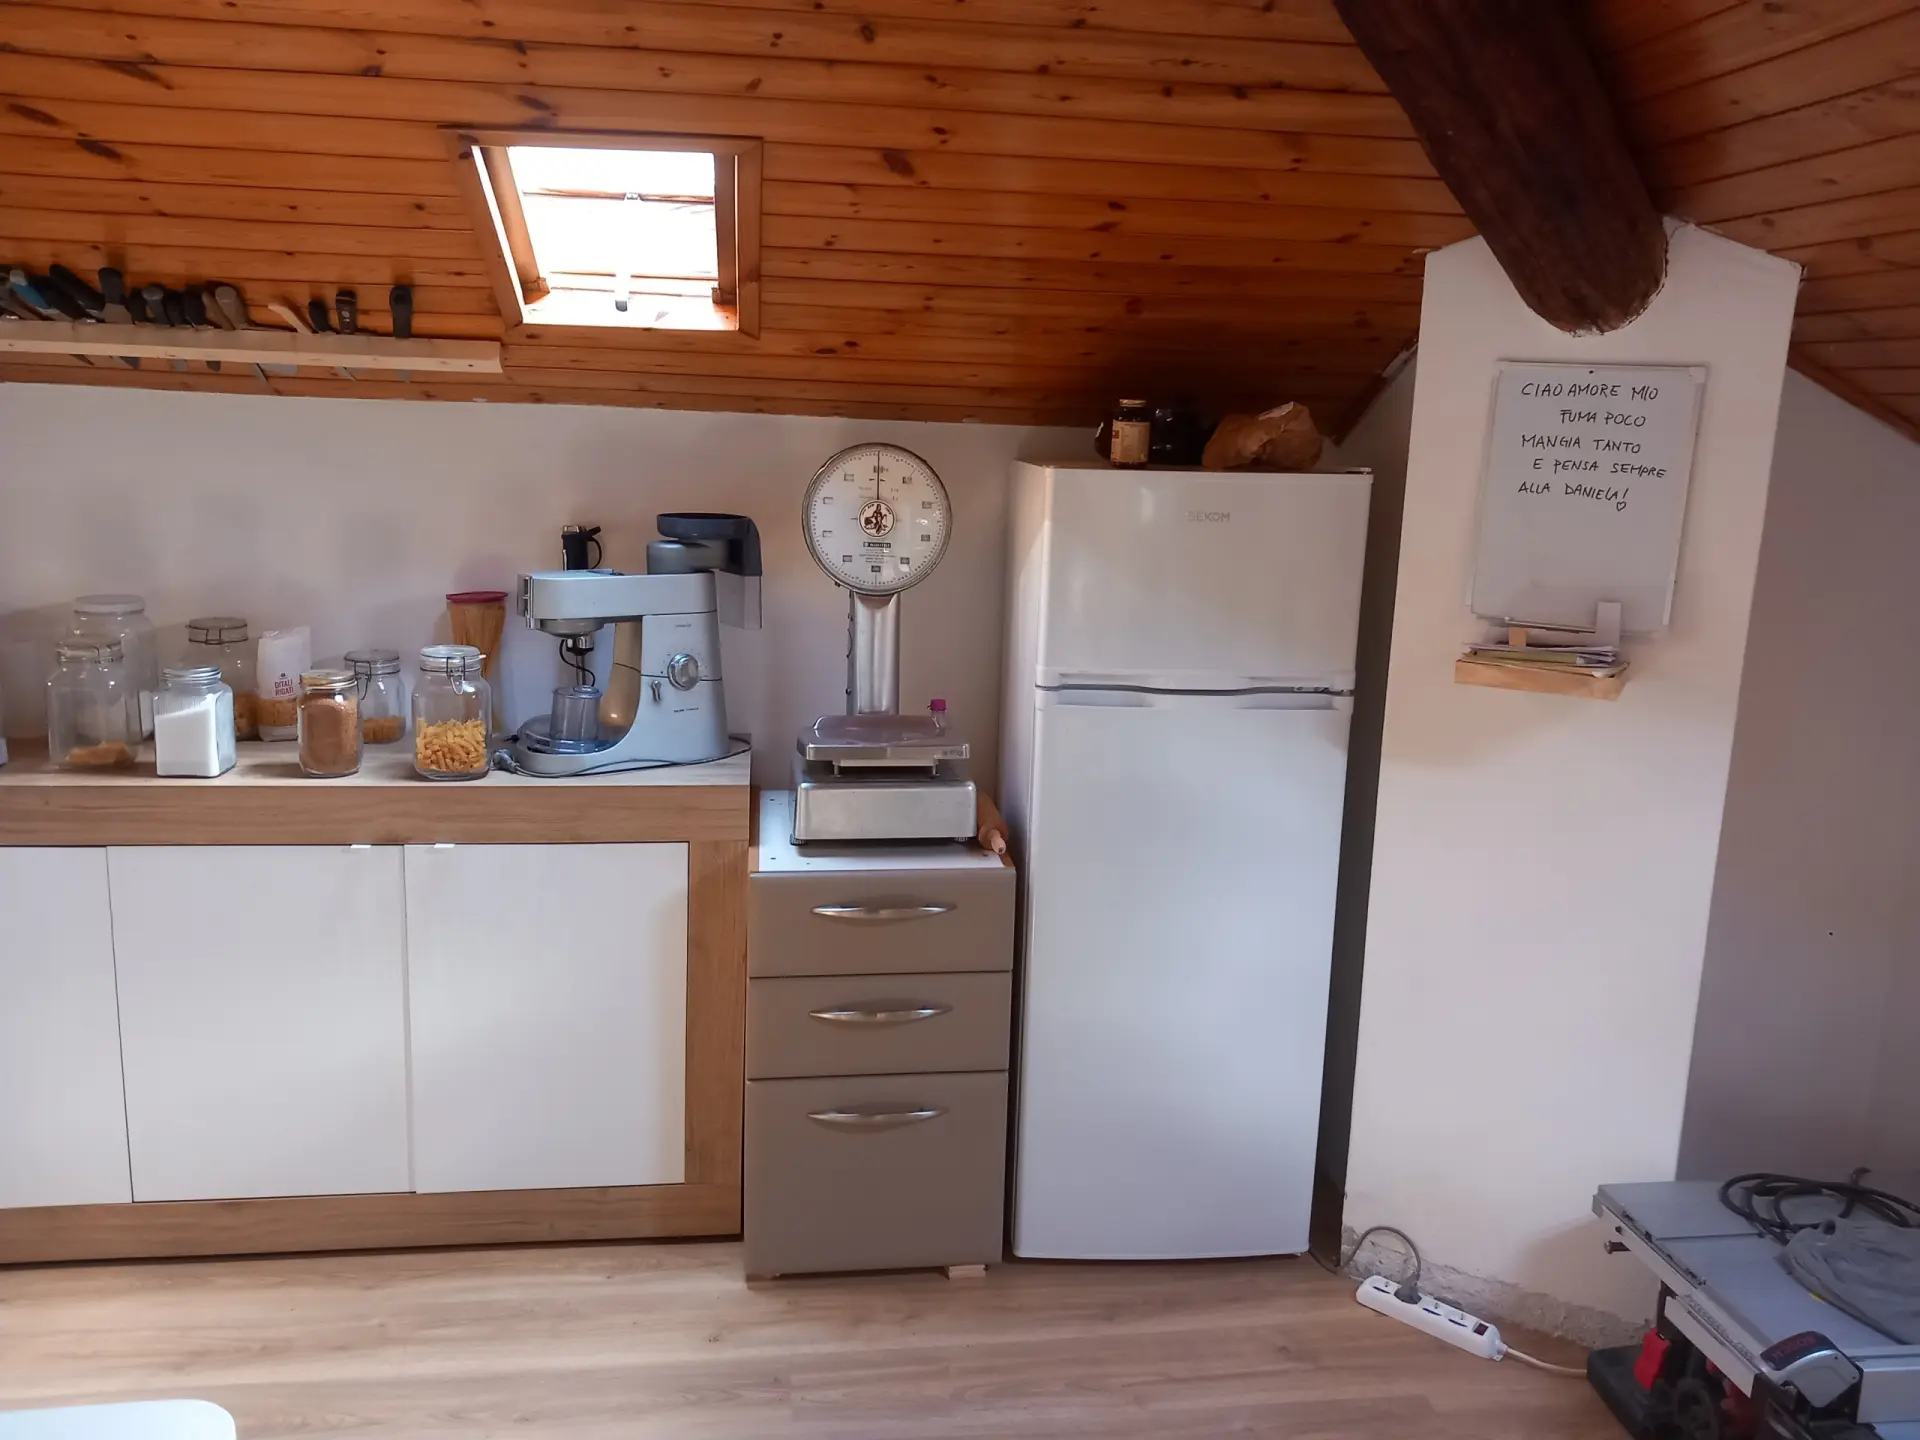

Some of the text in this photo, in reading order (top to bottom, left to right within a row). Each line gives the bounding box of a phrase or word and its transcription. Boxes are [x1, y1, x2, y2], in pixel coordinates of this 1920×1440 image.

[1521, 383, 1659, 401] CIAO AMORE MIO
[1560, 409, 1646, 427] FUMA POCO
[1521, 434, 1641, 454] MANGIA TANTO
[1533, 458, 1667, 479] E PENSA SEMPRE
[1518, 481, 1551, 493] ALLA
[274, 679, 293, 689] DITALI
